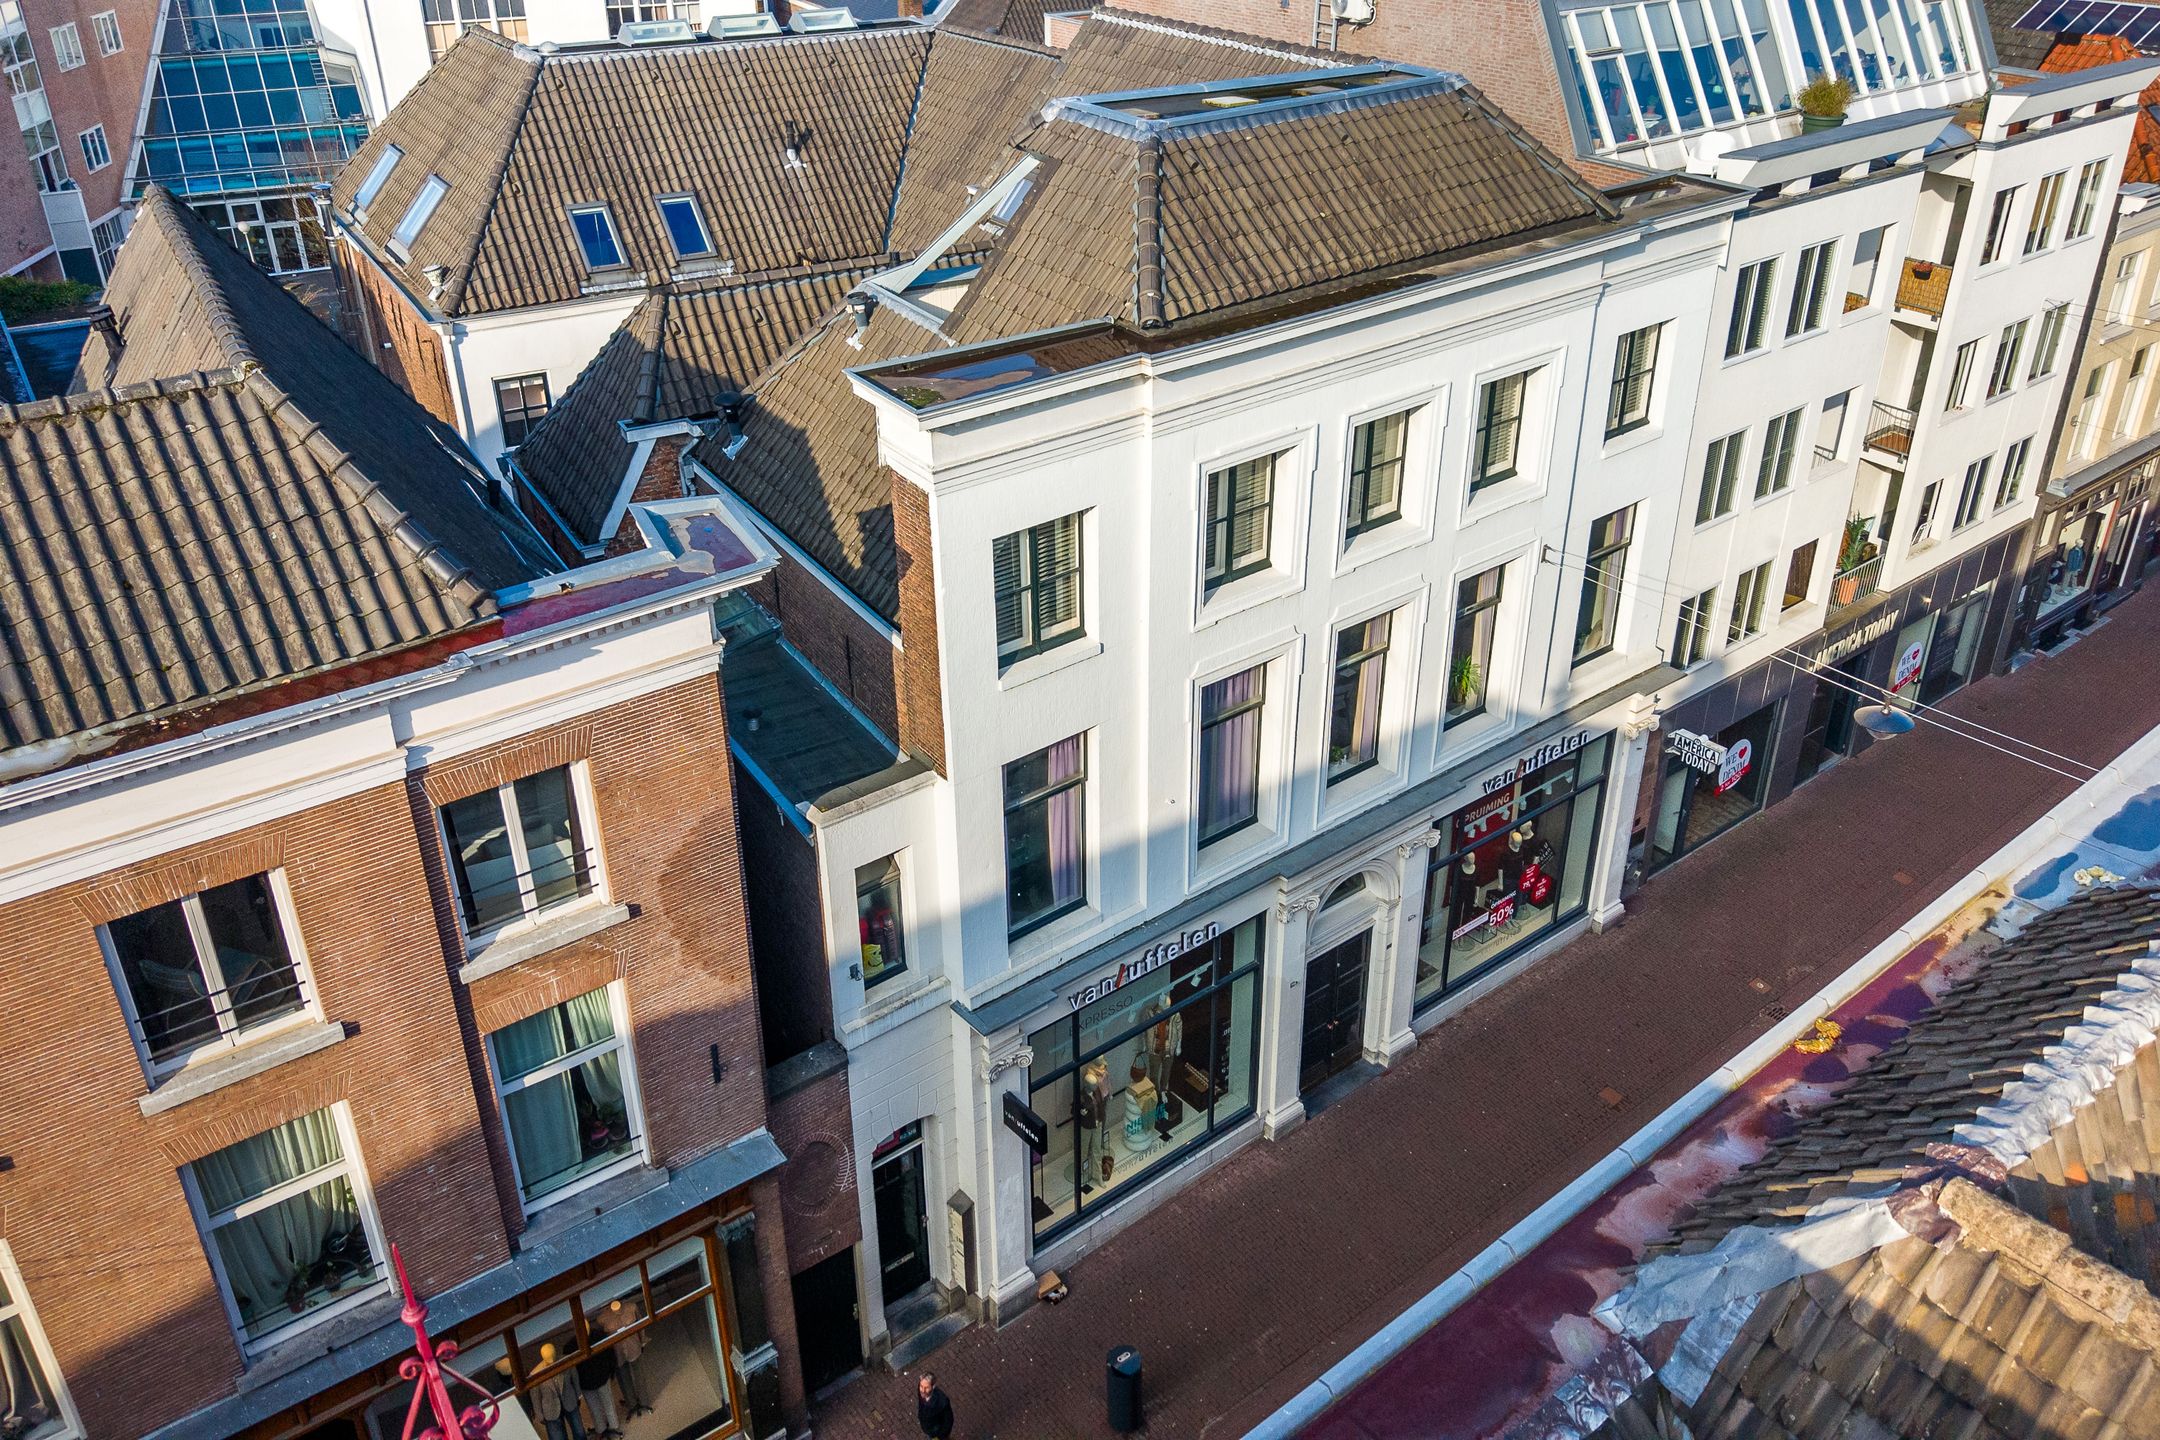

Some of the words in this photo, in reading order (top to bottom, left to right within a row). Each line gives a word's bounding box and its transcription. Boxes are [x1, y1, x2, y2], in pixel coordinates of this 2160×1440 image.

[1812, 629, 1863, 673] AMERICA
[1863, 609, 1899, 646] TODAY
[1676, 737, 1717, 764] AMERICA
[1681, 749, 1709, 773] TODAY
[1725, 752, 1738, 767] WE
[1489, 903, 1514, 926] 50%
